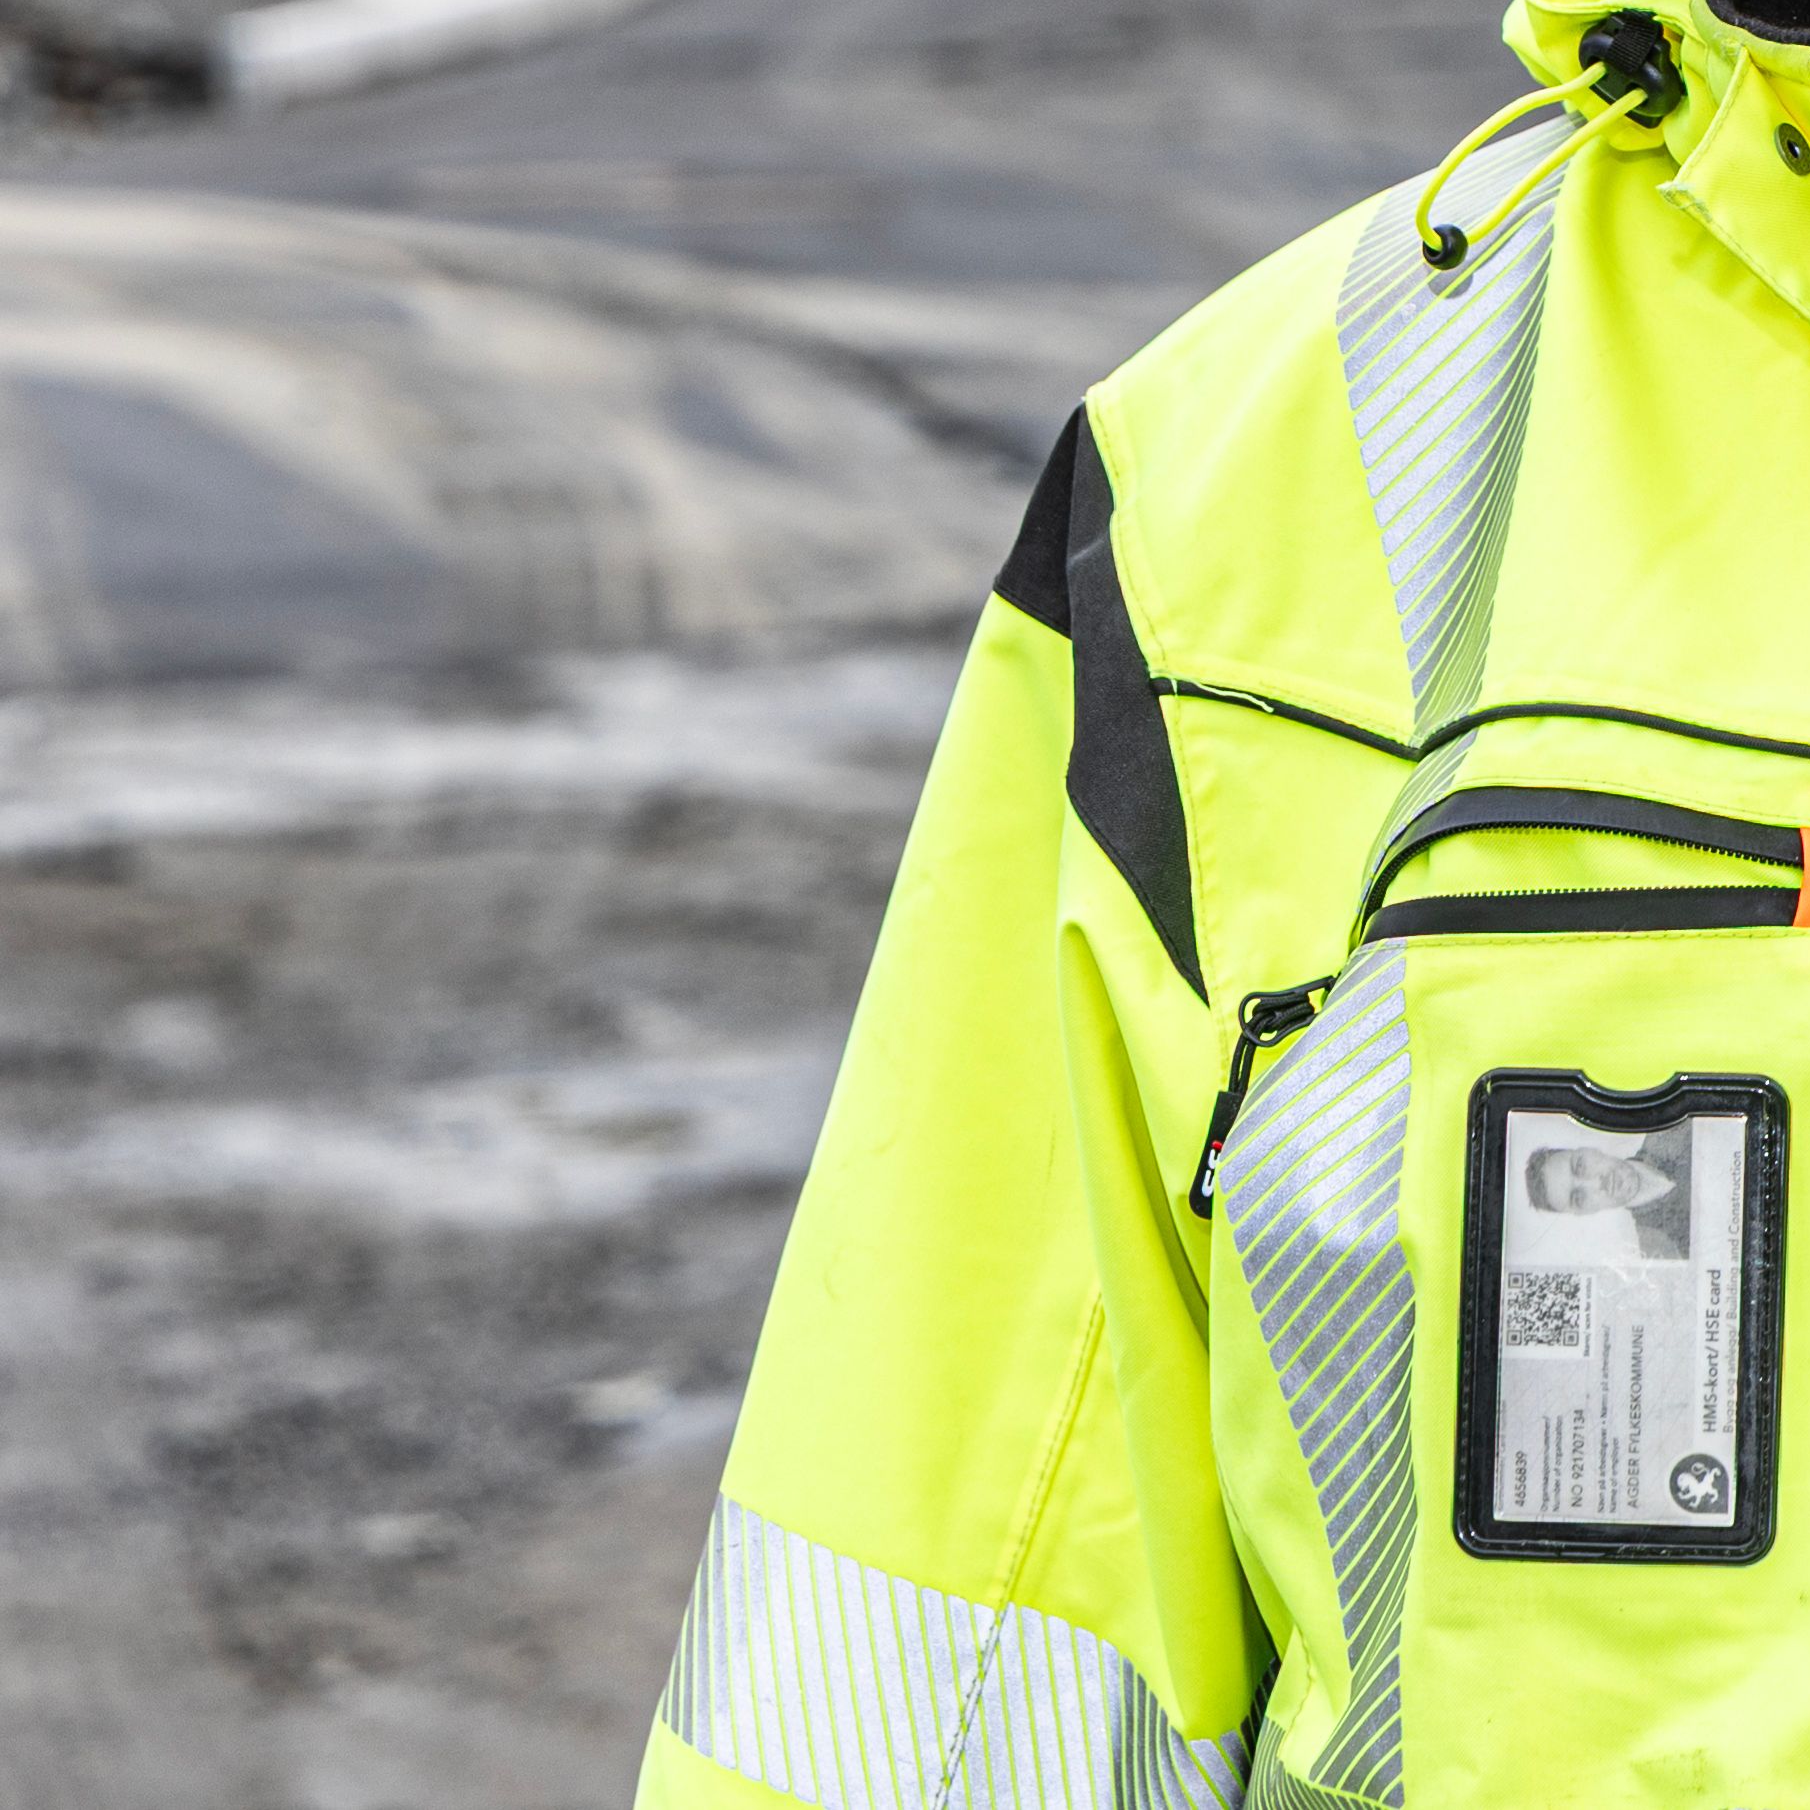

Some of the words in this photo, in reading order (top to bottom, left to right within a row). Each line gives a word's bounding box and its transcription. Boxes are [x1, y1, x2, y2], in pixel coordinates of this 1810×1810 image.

[1728, 1151, 1742, 1235] Construction
[1729, 1239, 1740, 1262] and
[1705, 1269, 1721, 1305] card
[1725, 1267, 1738, 1320] Building
[1704, 1308, 1720, 1343] HSE
[1629, 1324, 1644, 1454] FYLKESKOMMUNE
[1702, 1347, 1719, 1434] HMS-kort/
[1571, 1409, 1585, 1480] 921707134
[1515, 1451, 1527, 1507] 4656839
[1571, 1484, 1583, 1507] NO
[1627, 1458, 1640, 1509] AGDER
